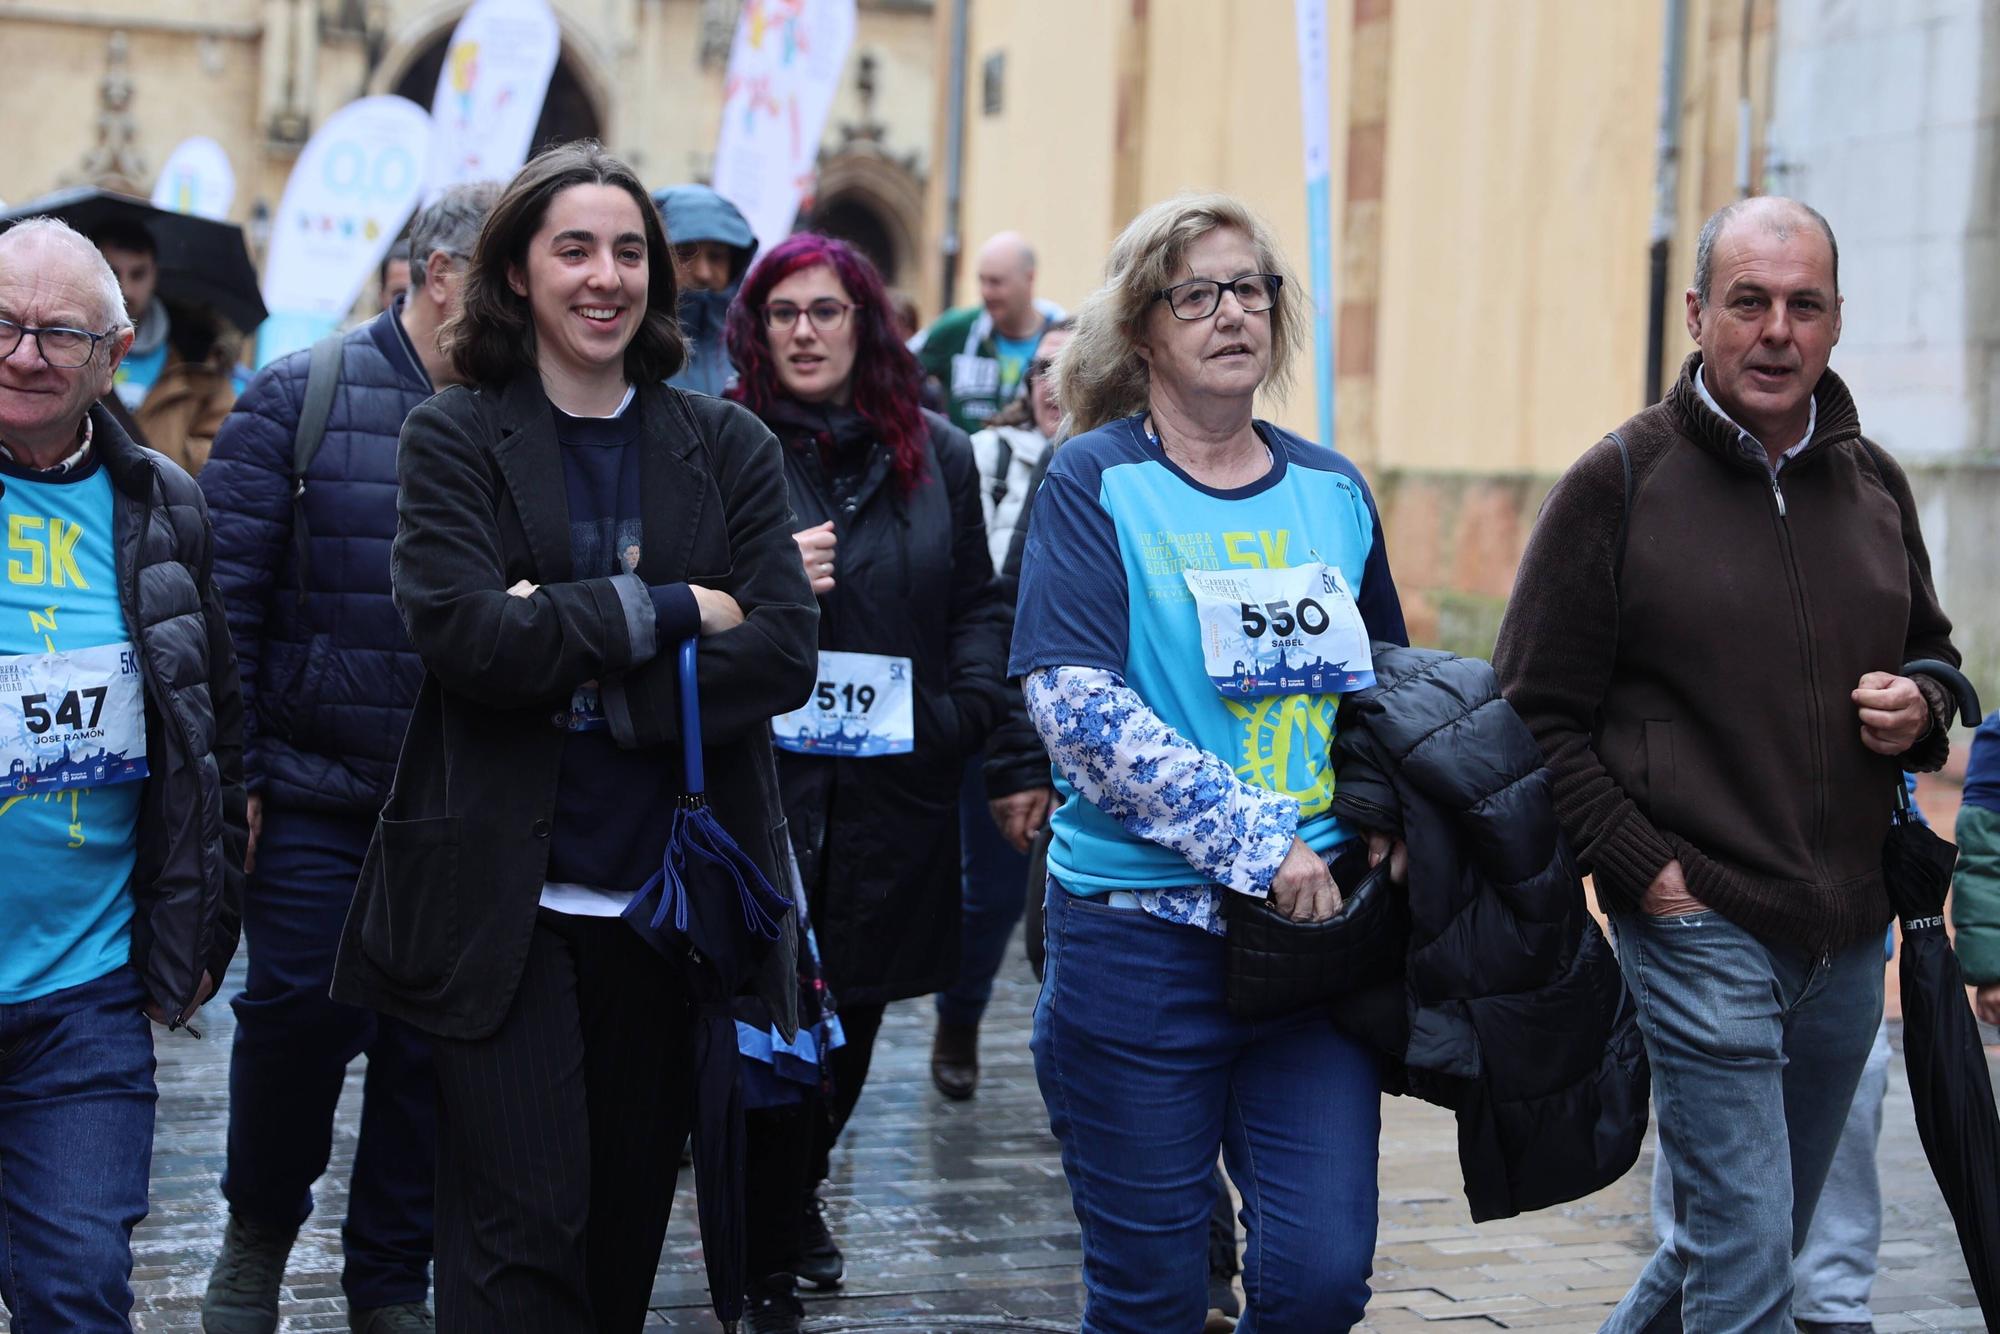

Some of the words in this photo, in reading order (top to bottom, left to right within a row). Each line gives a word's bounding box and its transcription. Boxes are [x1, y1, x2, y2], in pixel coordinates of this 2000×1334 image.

[1157, 530, 1213, 545] CARERA
[8, 514, 91, 590] 5K
[1222, 529, 1291, 570] 5K
[1146, 556, 1220, 575] SEGURDAD
[1321, 573, 1344, 594] 5K
[1241, 598, 1330, 638] 550
[1271, 638, 1305, 648] SABEL
[120, 650, 139, 675] 5K
[889, 663, 906, 681] 5K
[816, 681, 876, 713] 519
[21, 686, 109, 735] 547
[34, 733, 61, 745] JOSE
[64, 728, 105, 742] RAMÓN
